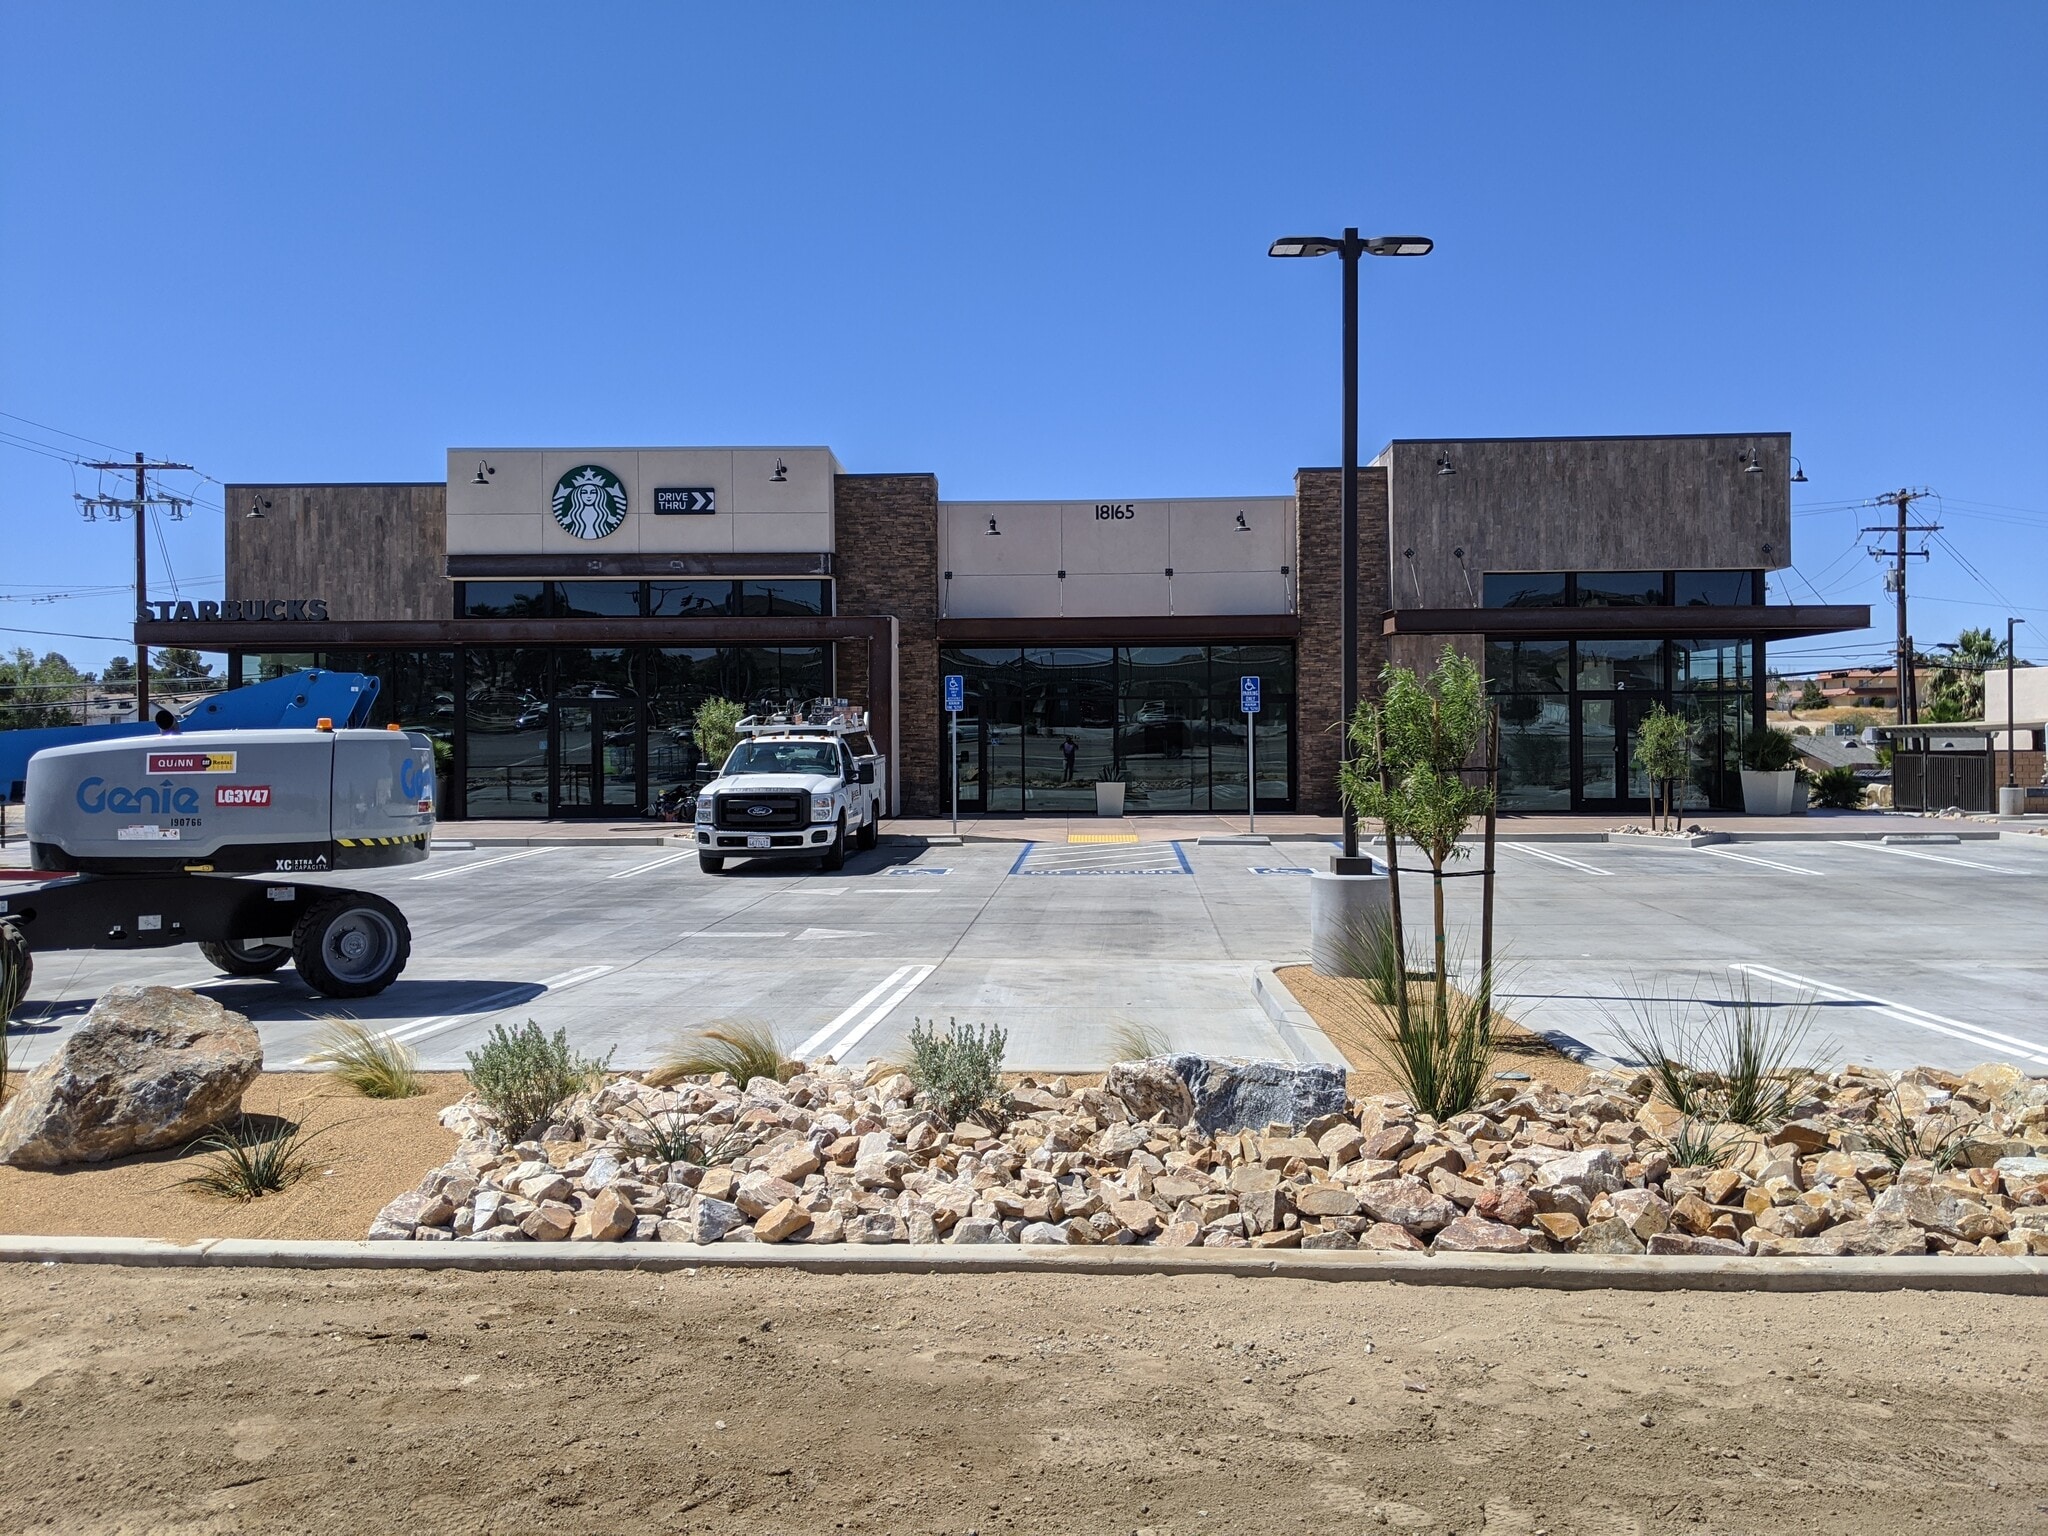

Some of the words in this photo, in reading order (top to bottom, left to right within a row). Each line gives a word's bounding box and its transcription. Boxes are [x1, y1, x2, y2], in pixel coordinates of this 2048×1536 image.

[658, 492, 688, 501] DRIVE
[658, 501, 687, 510] THRU
[1095, 504, 1135, 520] 18165
[137, 600, 329, 622] STARBUCKS
[1617, 681, 1625, 690] 2
[76, 776, 199, 814] Genie
[217, 789, 269, 804] LG3Y47
[276, 859, 292, 871] XC
